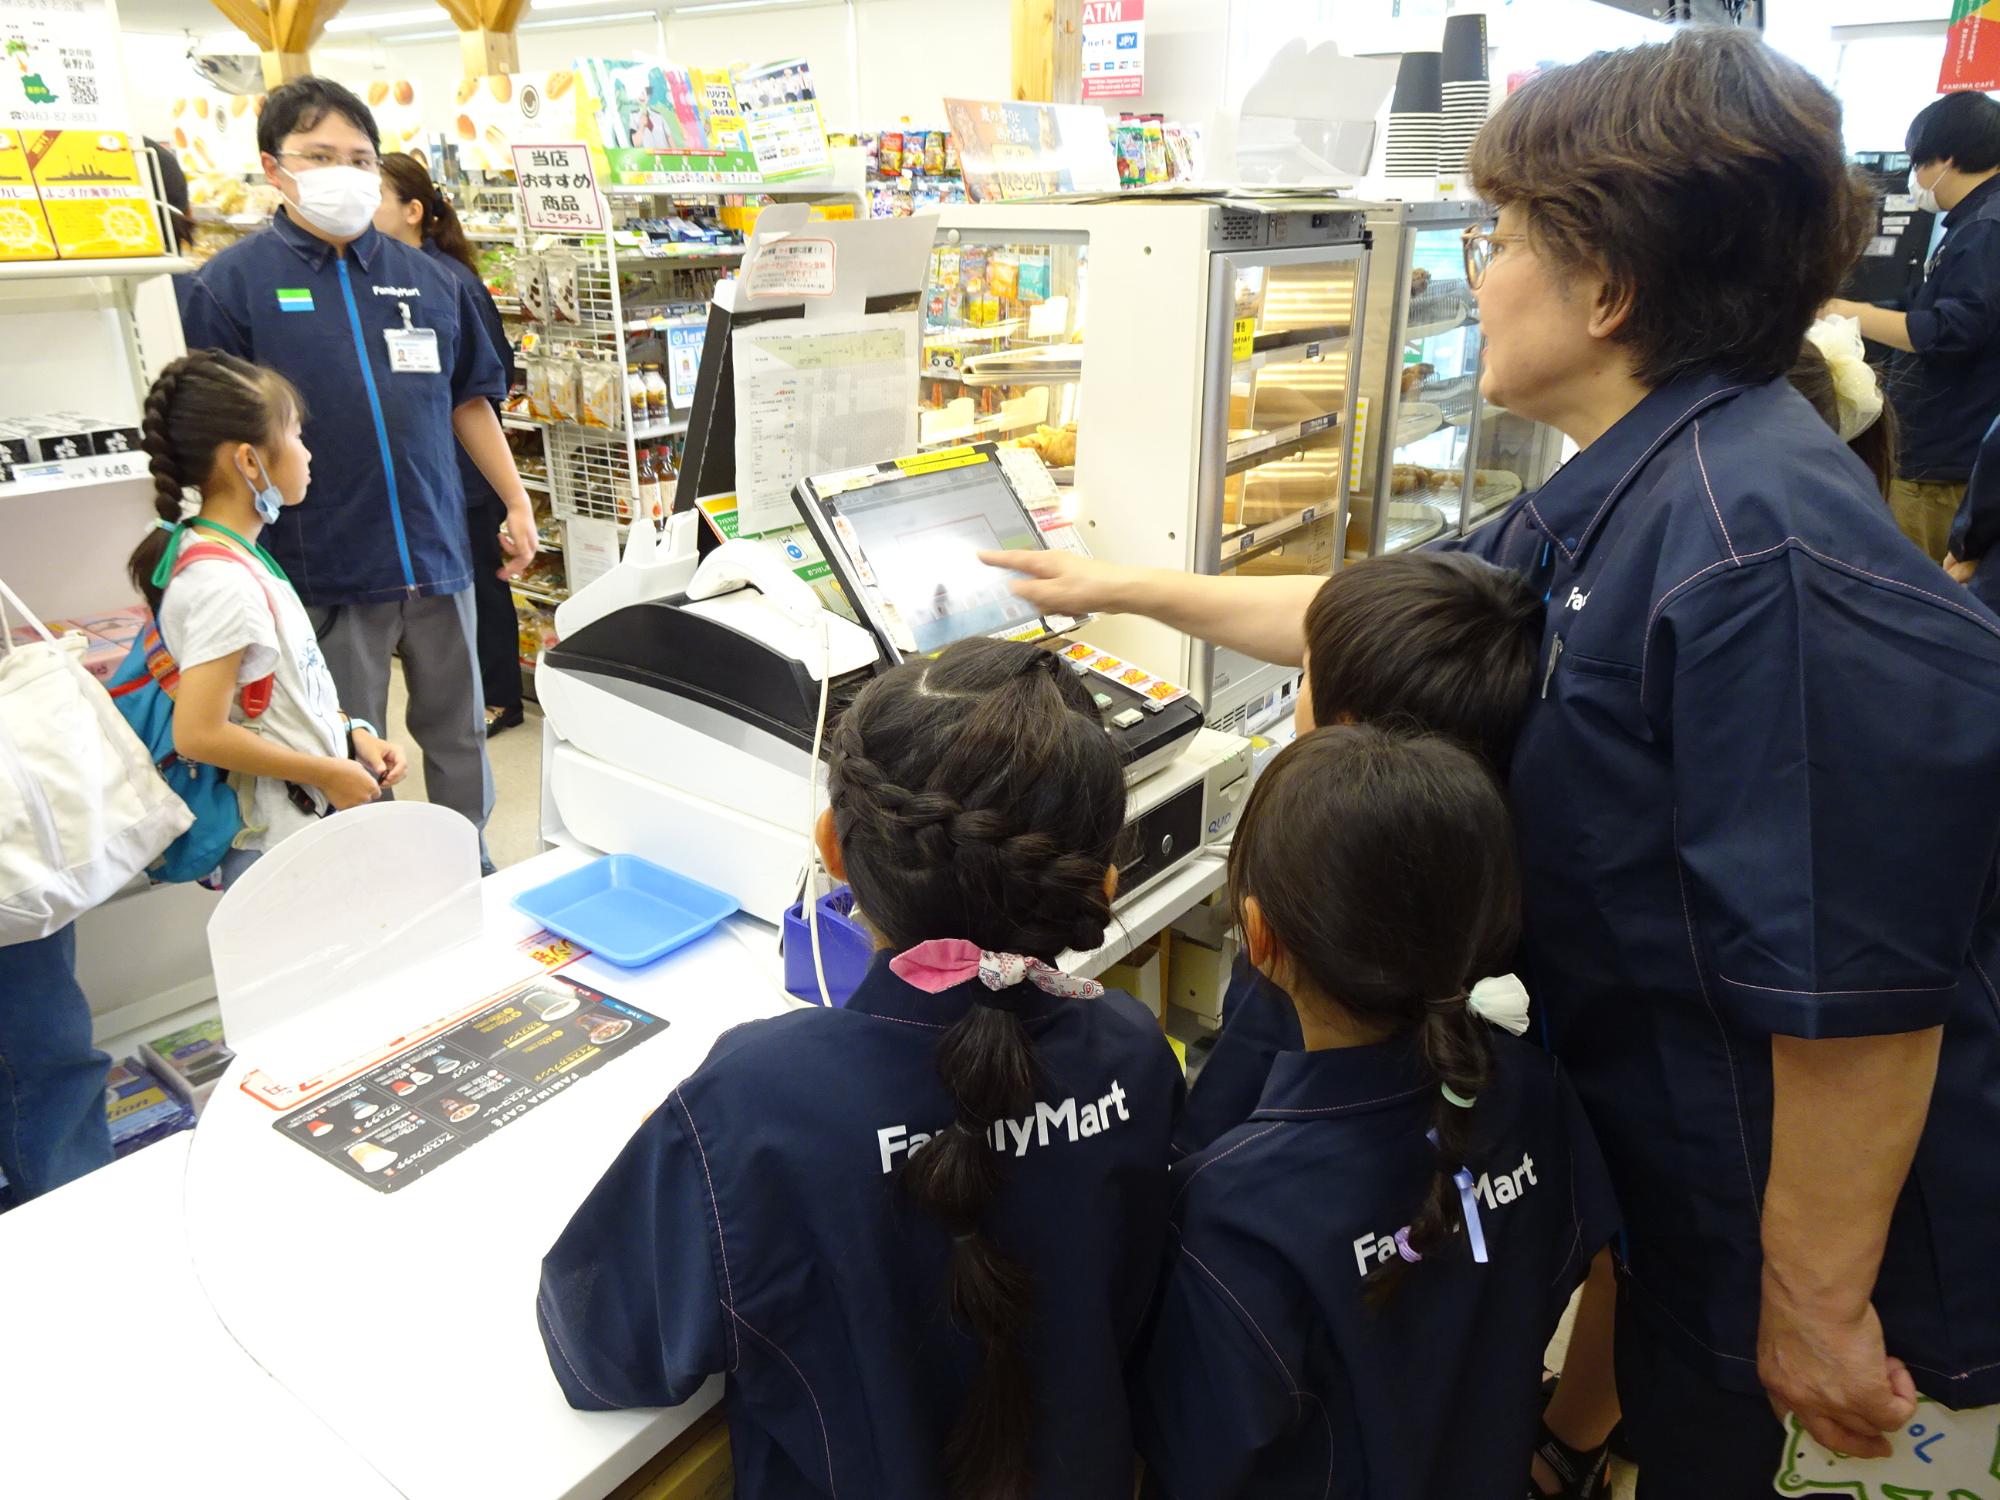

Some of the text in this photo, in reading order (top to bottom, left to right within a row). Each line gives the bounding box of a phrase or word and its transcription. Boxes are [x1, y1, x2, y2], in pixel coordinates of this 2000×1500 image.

[1083, 2, 1121, 24] ATM
[532, 150, 569, 166] 当店
[521, 172, 591, 188] おすすめ
[540, 195, 580, 211] 商品
[546, 212, 582, 224] こちら
[372, 286, 421, 298] FamilyMart
[489, 1072, 579, 1127] FAMIMA CAFÉ
[877, 1079, 1130, 1174] FalyMart
